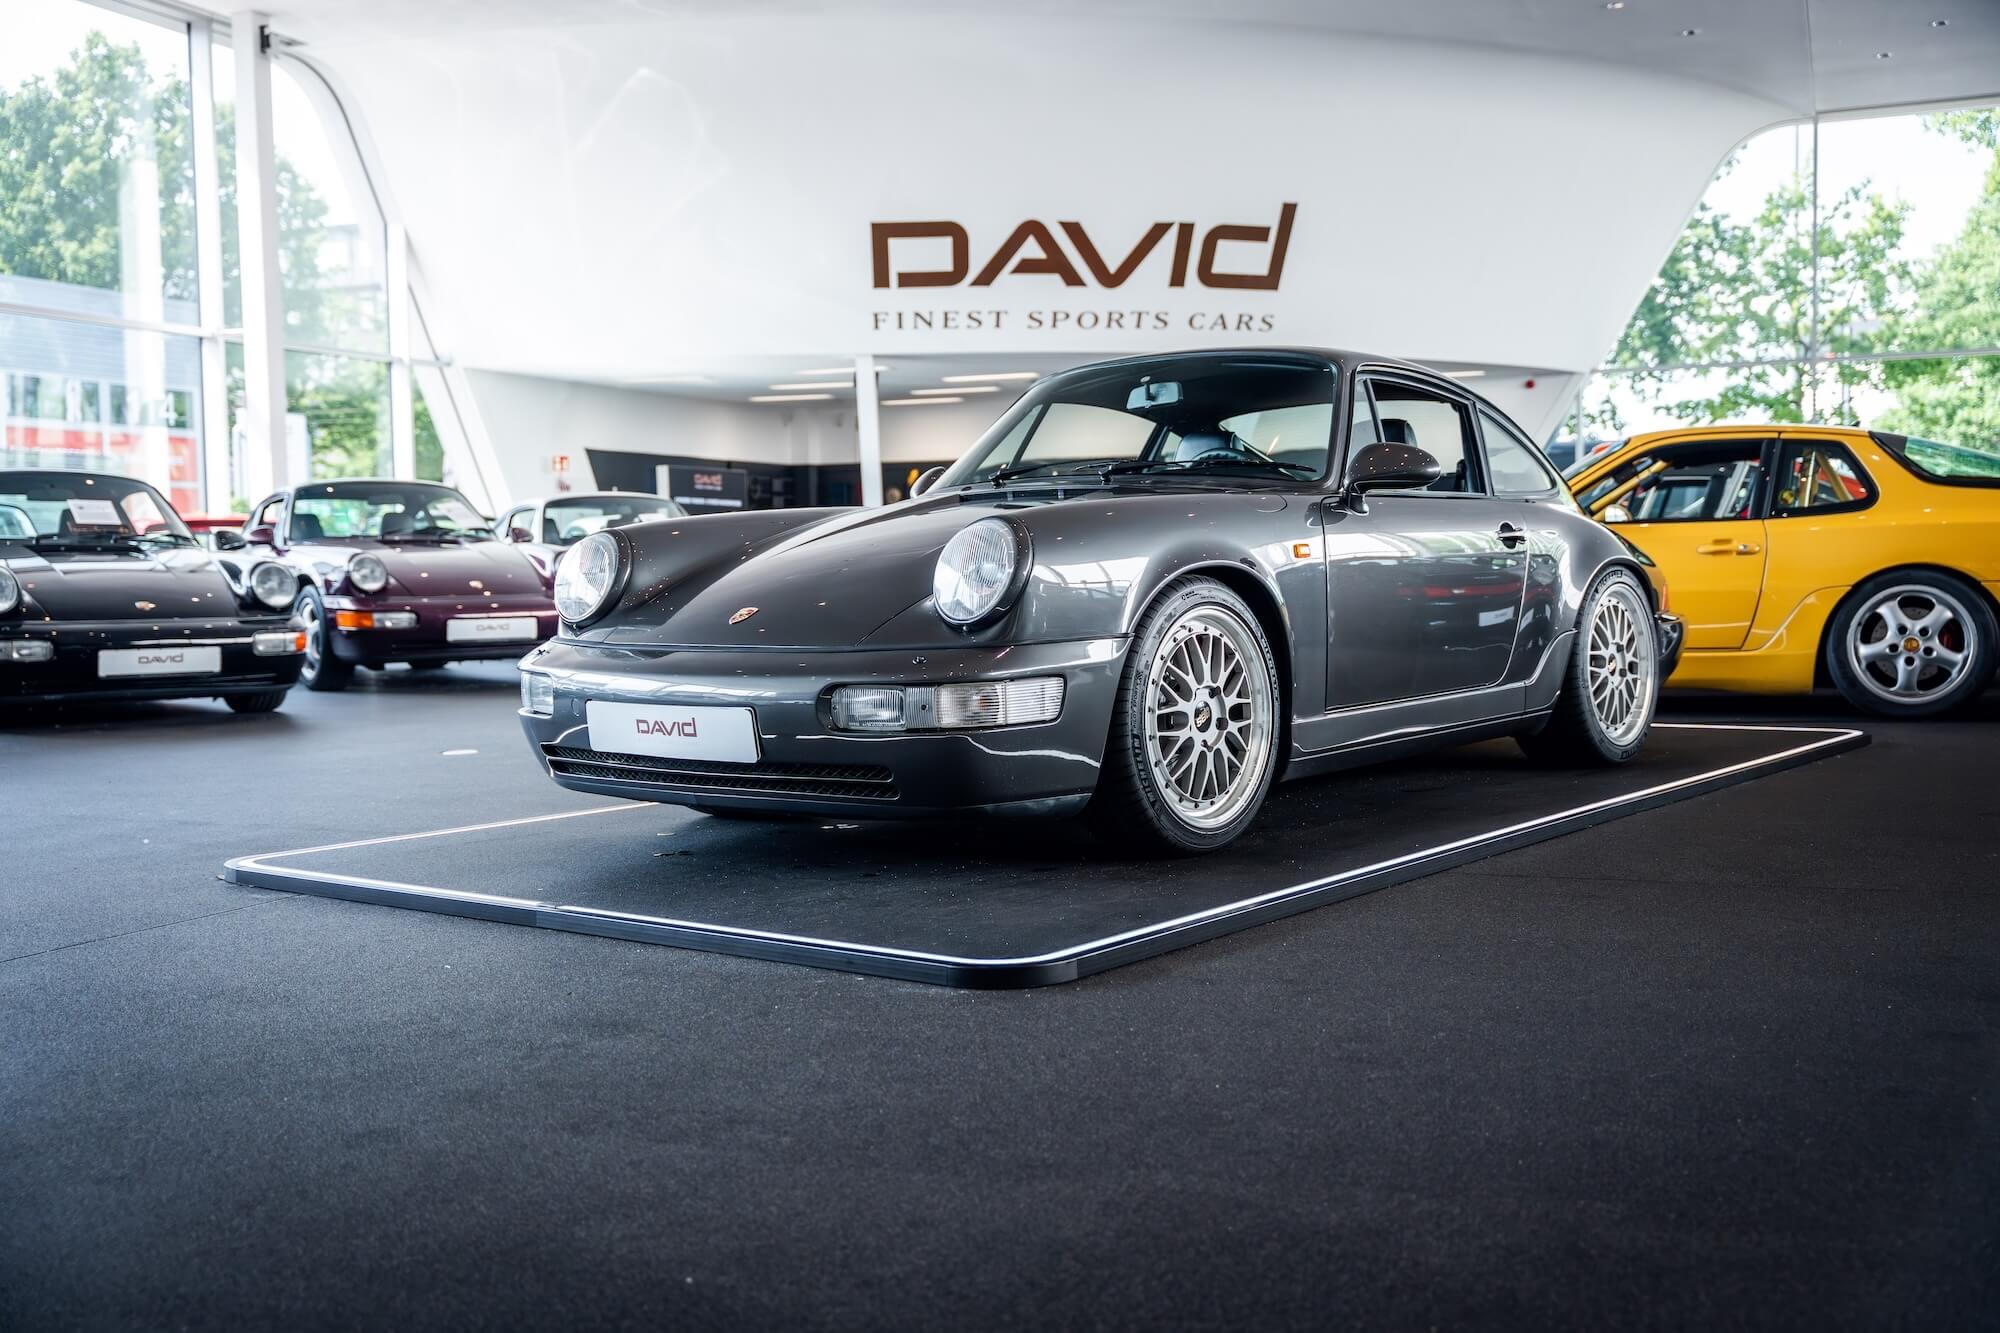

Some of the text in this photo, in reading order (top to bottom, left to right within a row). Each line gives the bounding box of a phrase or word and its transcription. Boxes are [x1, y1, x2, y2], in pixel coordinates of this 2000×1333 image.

[872, 310, 1276, 332] FINEST SPORTS CARS
